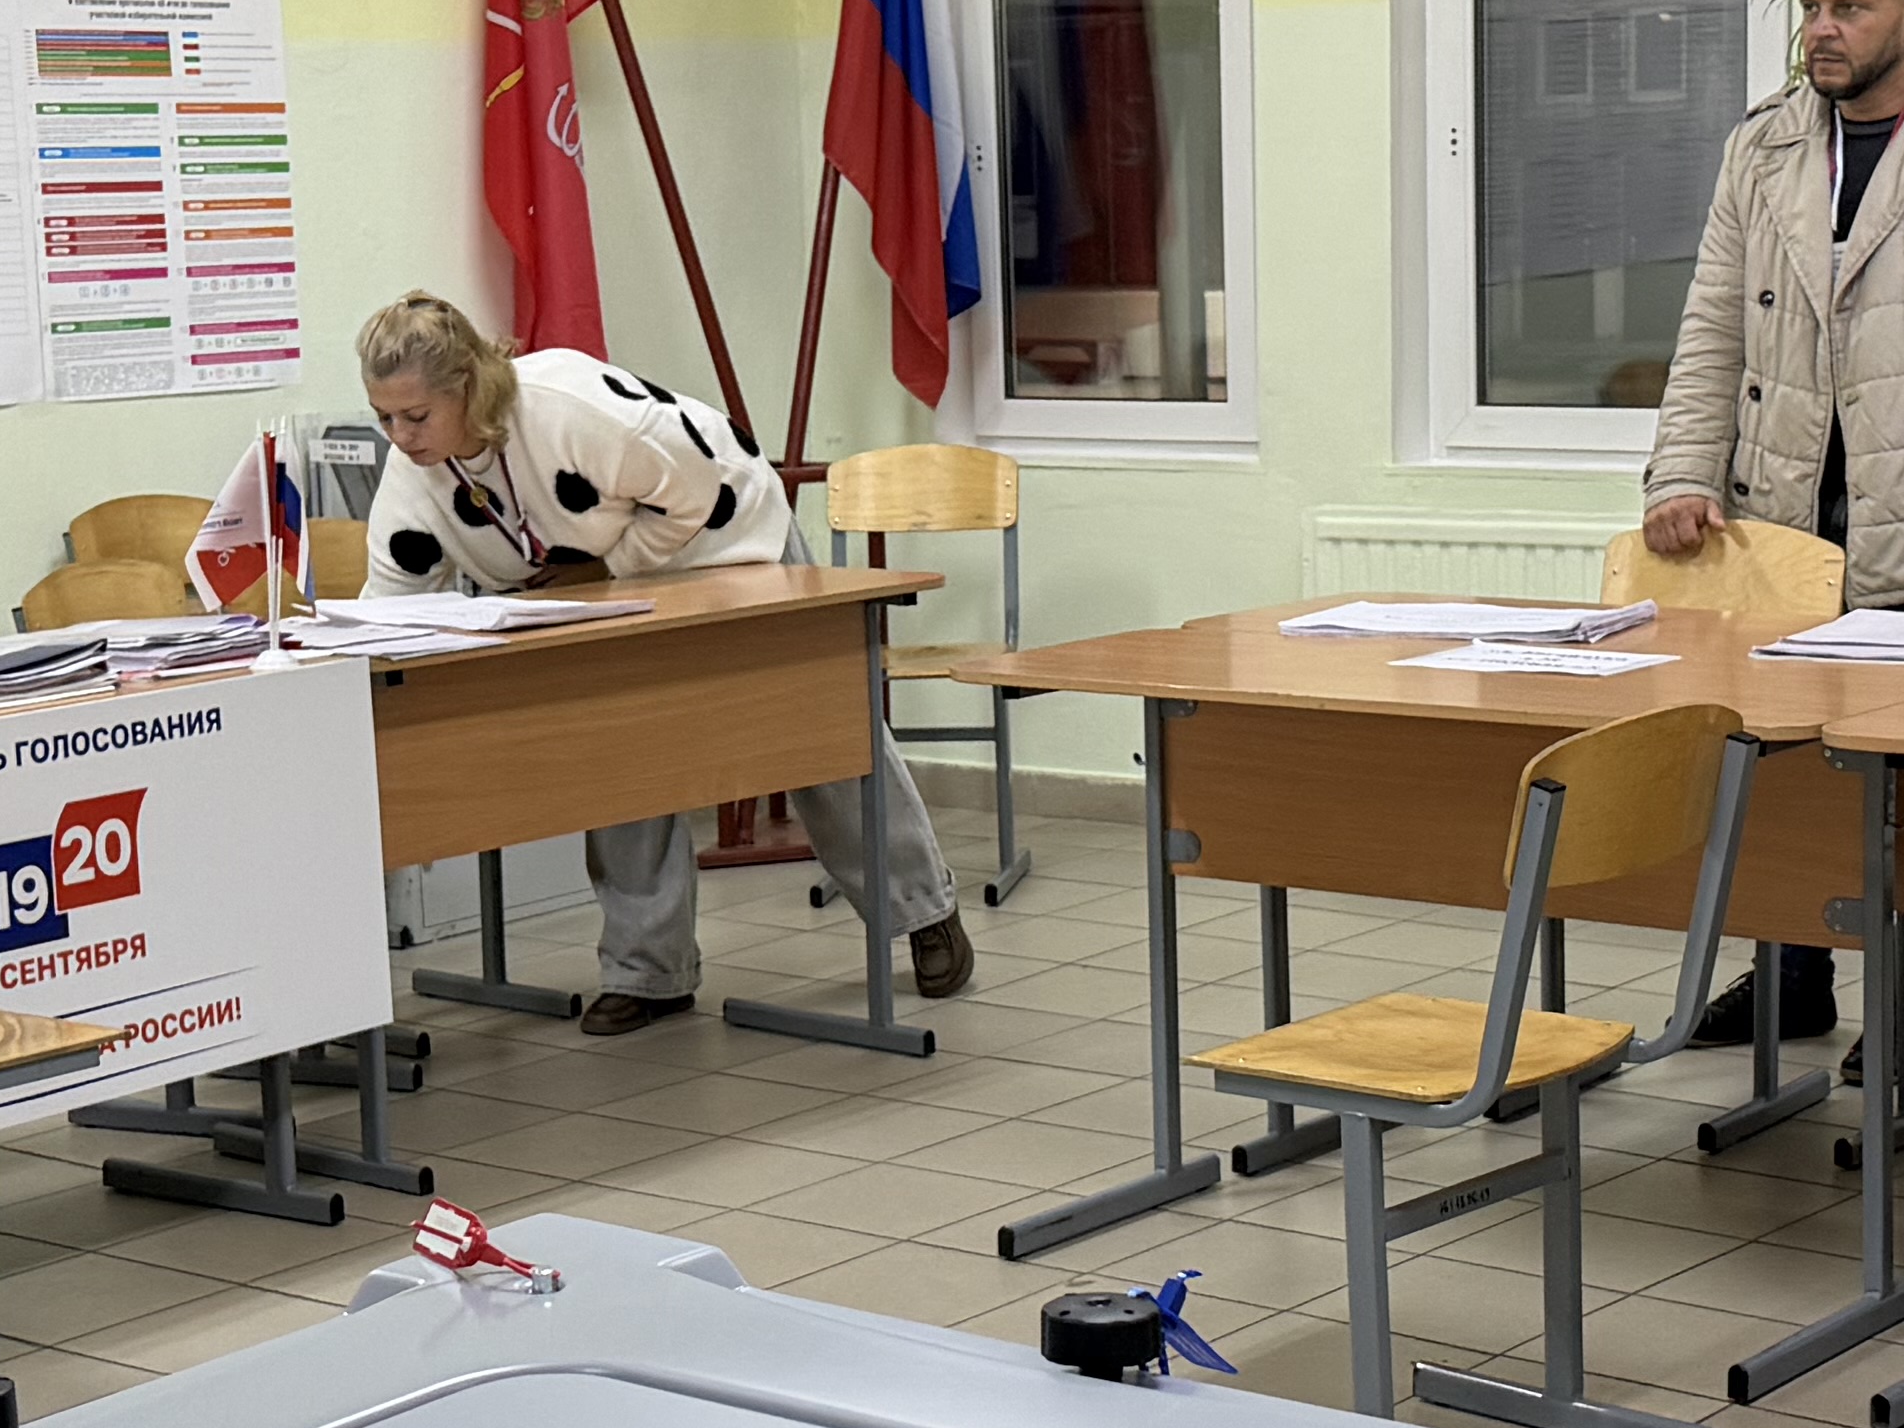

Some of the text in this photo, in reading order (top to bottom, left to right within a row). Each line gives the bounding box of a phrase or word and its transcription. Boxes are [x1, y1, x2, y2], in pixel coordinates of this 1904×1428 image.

[15, 706, 223, 768] ГОЛОСОВАНИЯ
[59, 817, 132, 886] 20
[0, 933, 148, 990] СЕНТЯБРЯ
[125, 996, 243, 1049] РОССИИ!
